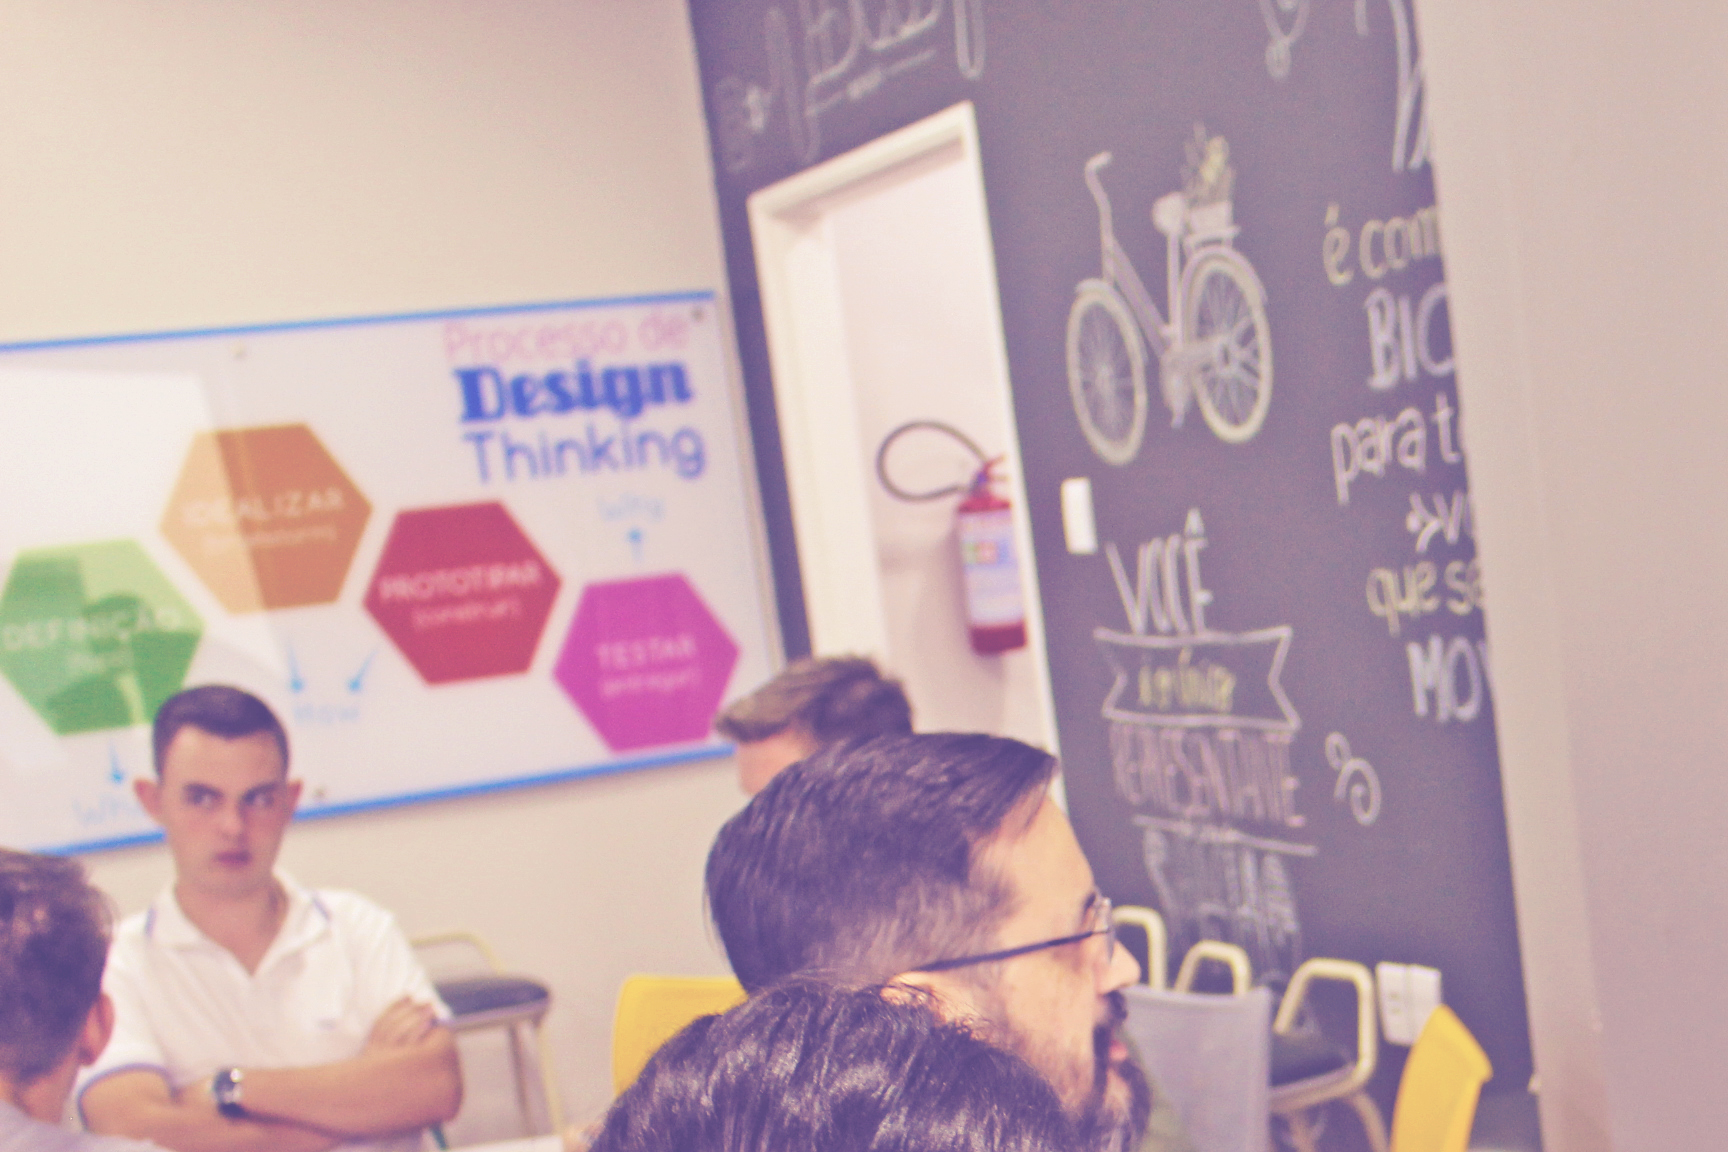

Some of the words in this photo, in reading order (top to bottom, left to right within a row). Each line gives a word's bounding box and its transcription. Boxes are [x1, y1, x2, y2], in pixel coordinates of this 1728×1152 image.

[442, 318, 629, 361] Processo
[636, 312, 692, 350] de
[1364, 287, 1456, 390] BIC
[452, 358, 695, 425] Design
[461, 422, 707, 486] Thinking
[1330, 406, 1428, 505] para
